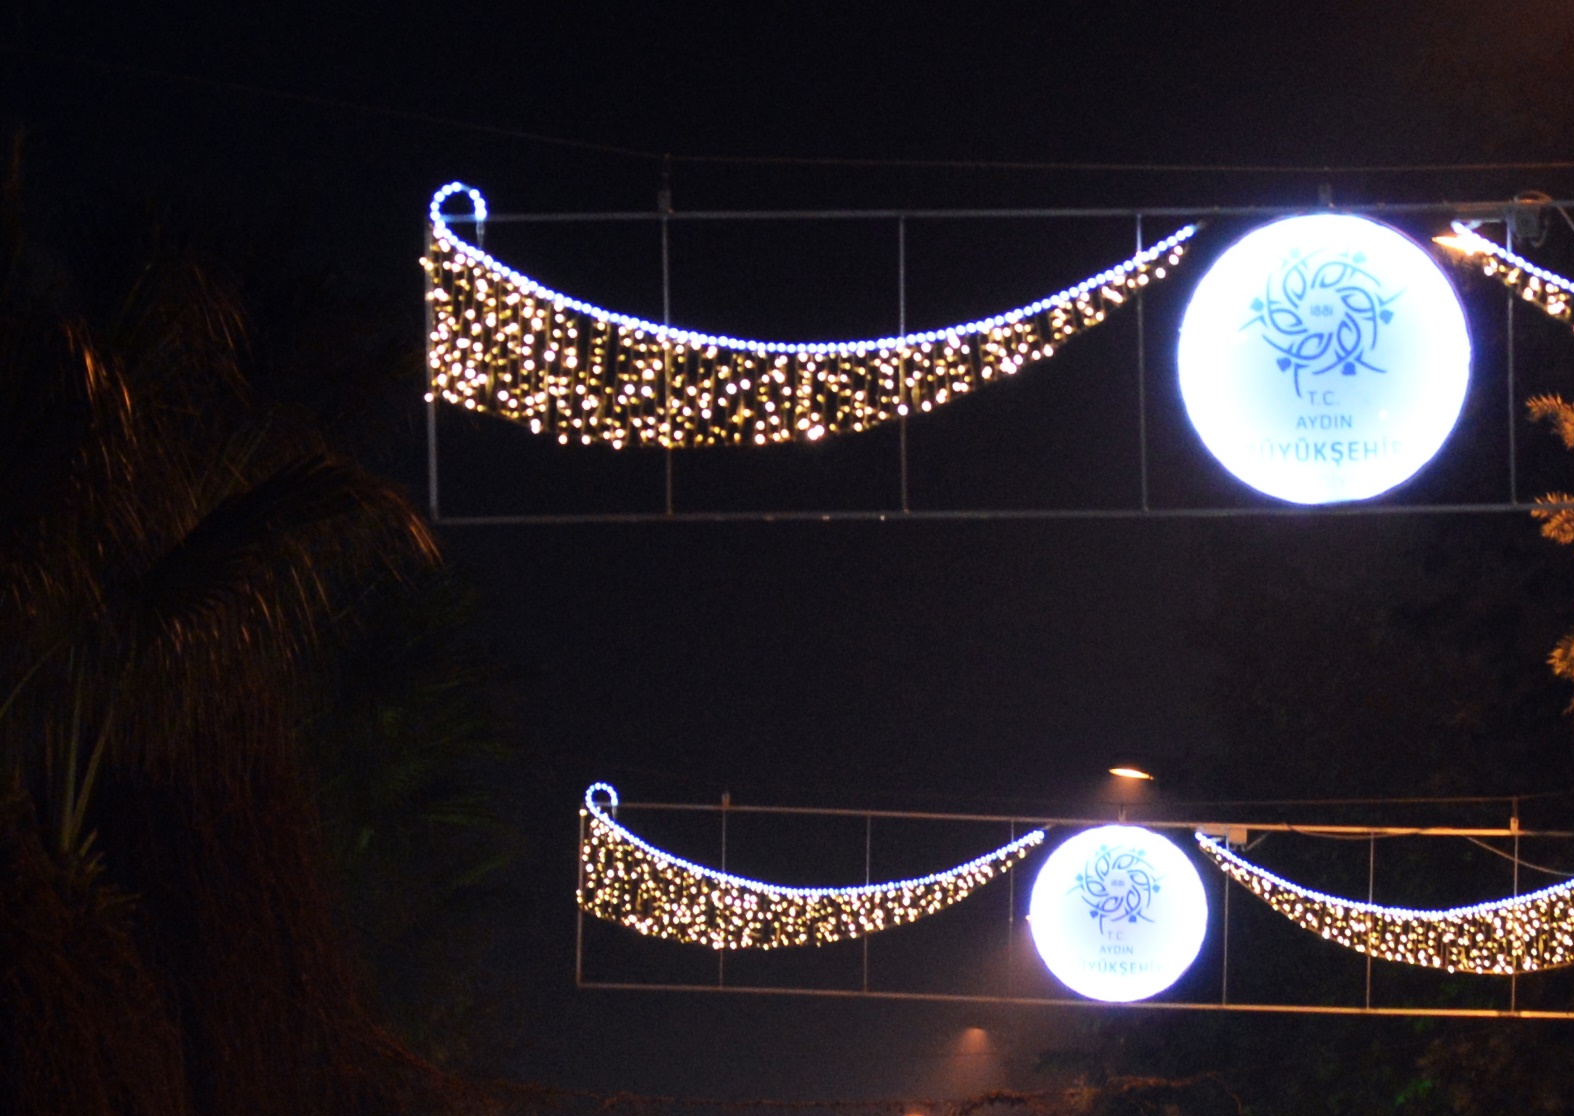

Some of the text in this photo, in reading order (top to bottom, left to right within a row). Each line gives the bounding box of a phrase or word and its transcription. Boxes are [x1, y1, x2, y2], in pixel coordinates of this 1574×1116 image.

[1308, 390, 1340, 407] T.C.
[1295, 414, 1354, 431] AYDIN
[1100, 945, 1133, 955] AYDIN
